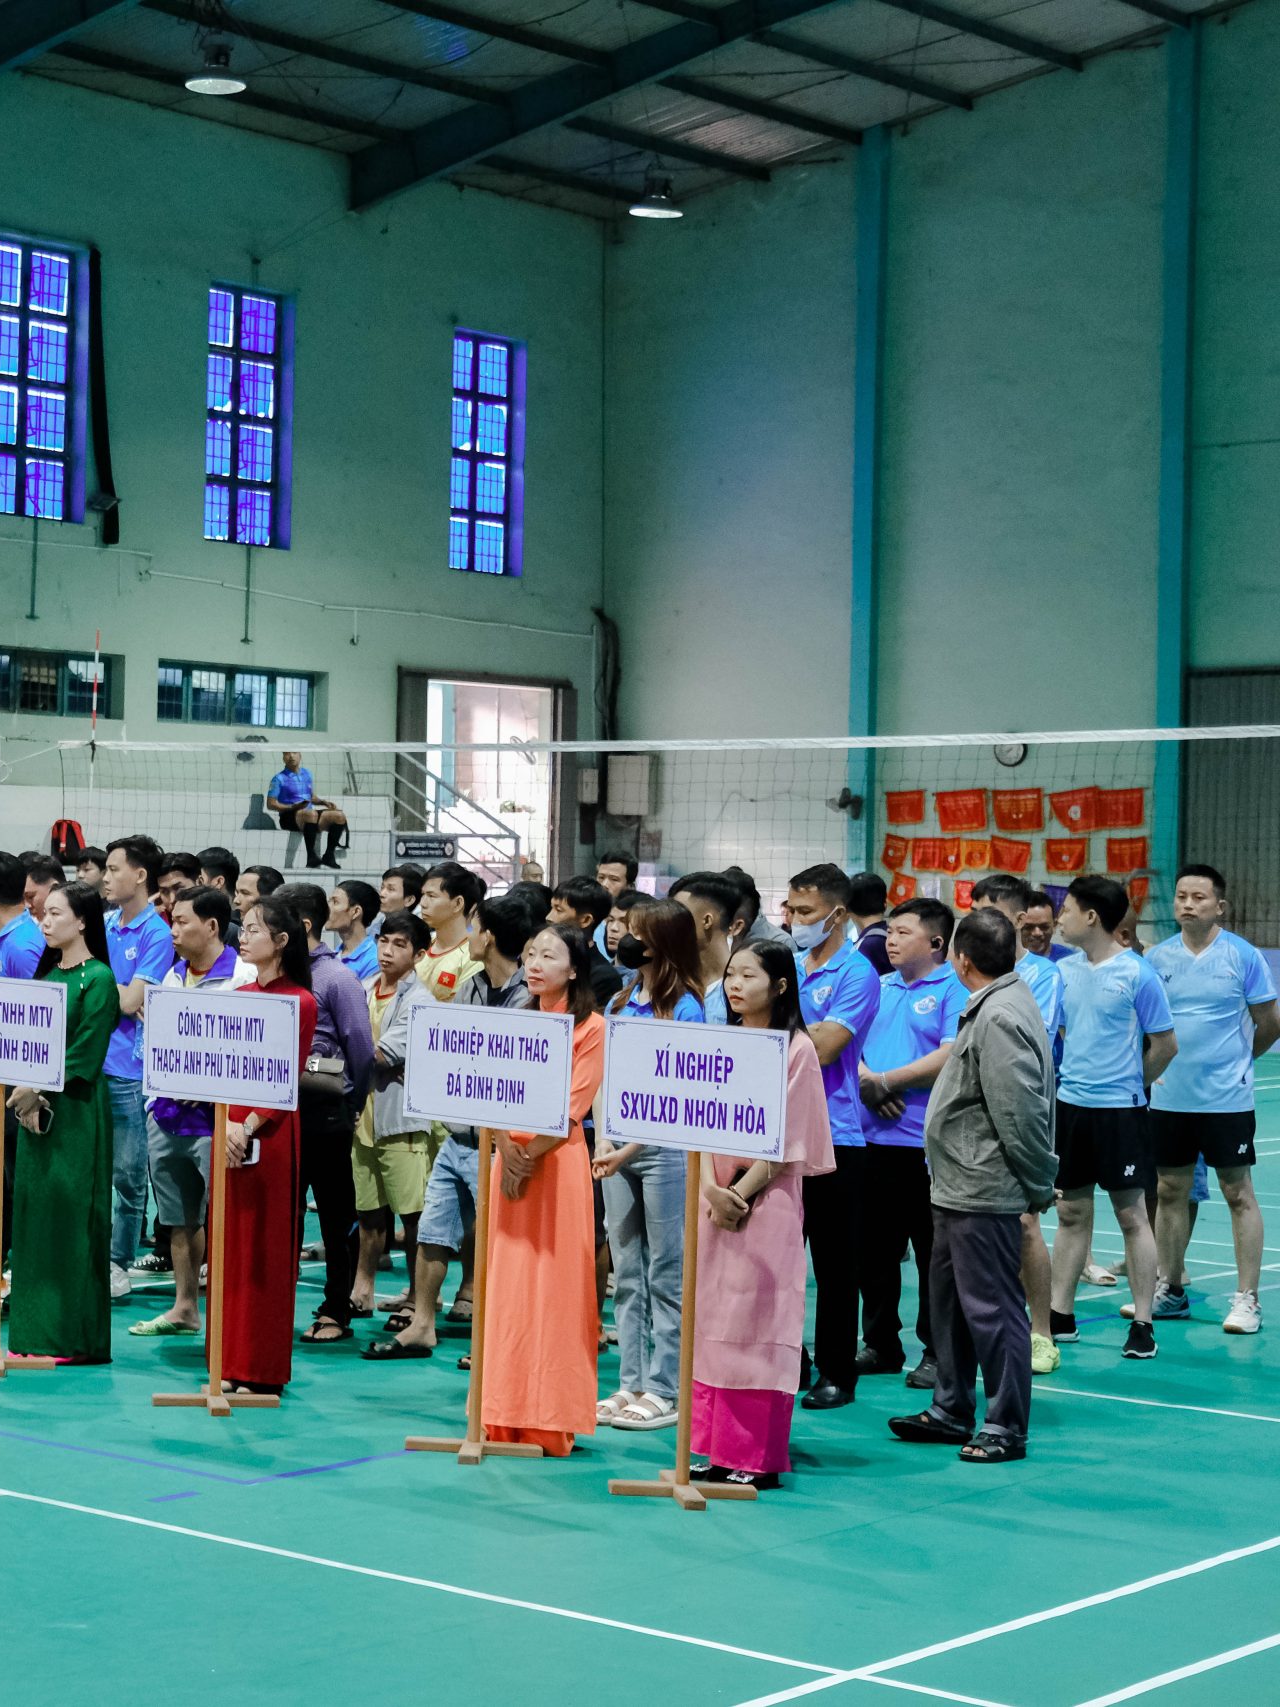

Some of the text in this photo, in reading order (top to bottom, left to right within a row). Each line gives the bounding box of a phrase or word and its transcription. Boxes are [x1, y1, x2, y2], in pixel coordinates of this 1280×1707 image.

[29, 1005, 52, 1028] MTV
[178, 1006, 264, 1042] CÔNG TY TNHH MTV
[22, 1040, 48, 1068] ĐỊNH
[428, 1022, 548, 1063] XÍ NGHIỆP KHAI THÁC
[152, 1047, 289, 1088] THẠCH ANH PHÚ TÀI BÌNH ĐỊNH
[655, 1043, 734, 1090] XÍ NGHIỆP
[447, 1068, 525, 1108] ĐÁ BÌNH ĐỊNH
[621, 1091, 766, 1135] SXVLXD NHƠN HÒA
